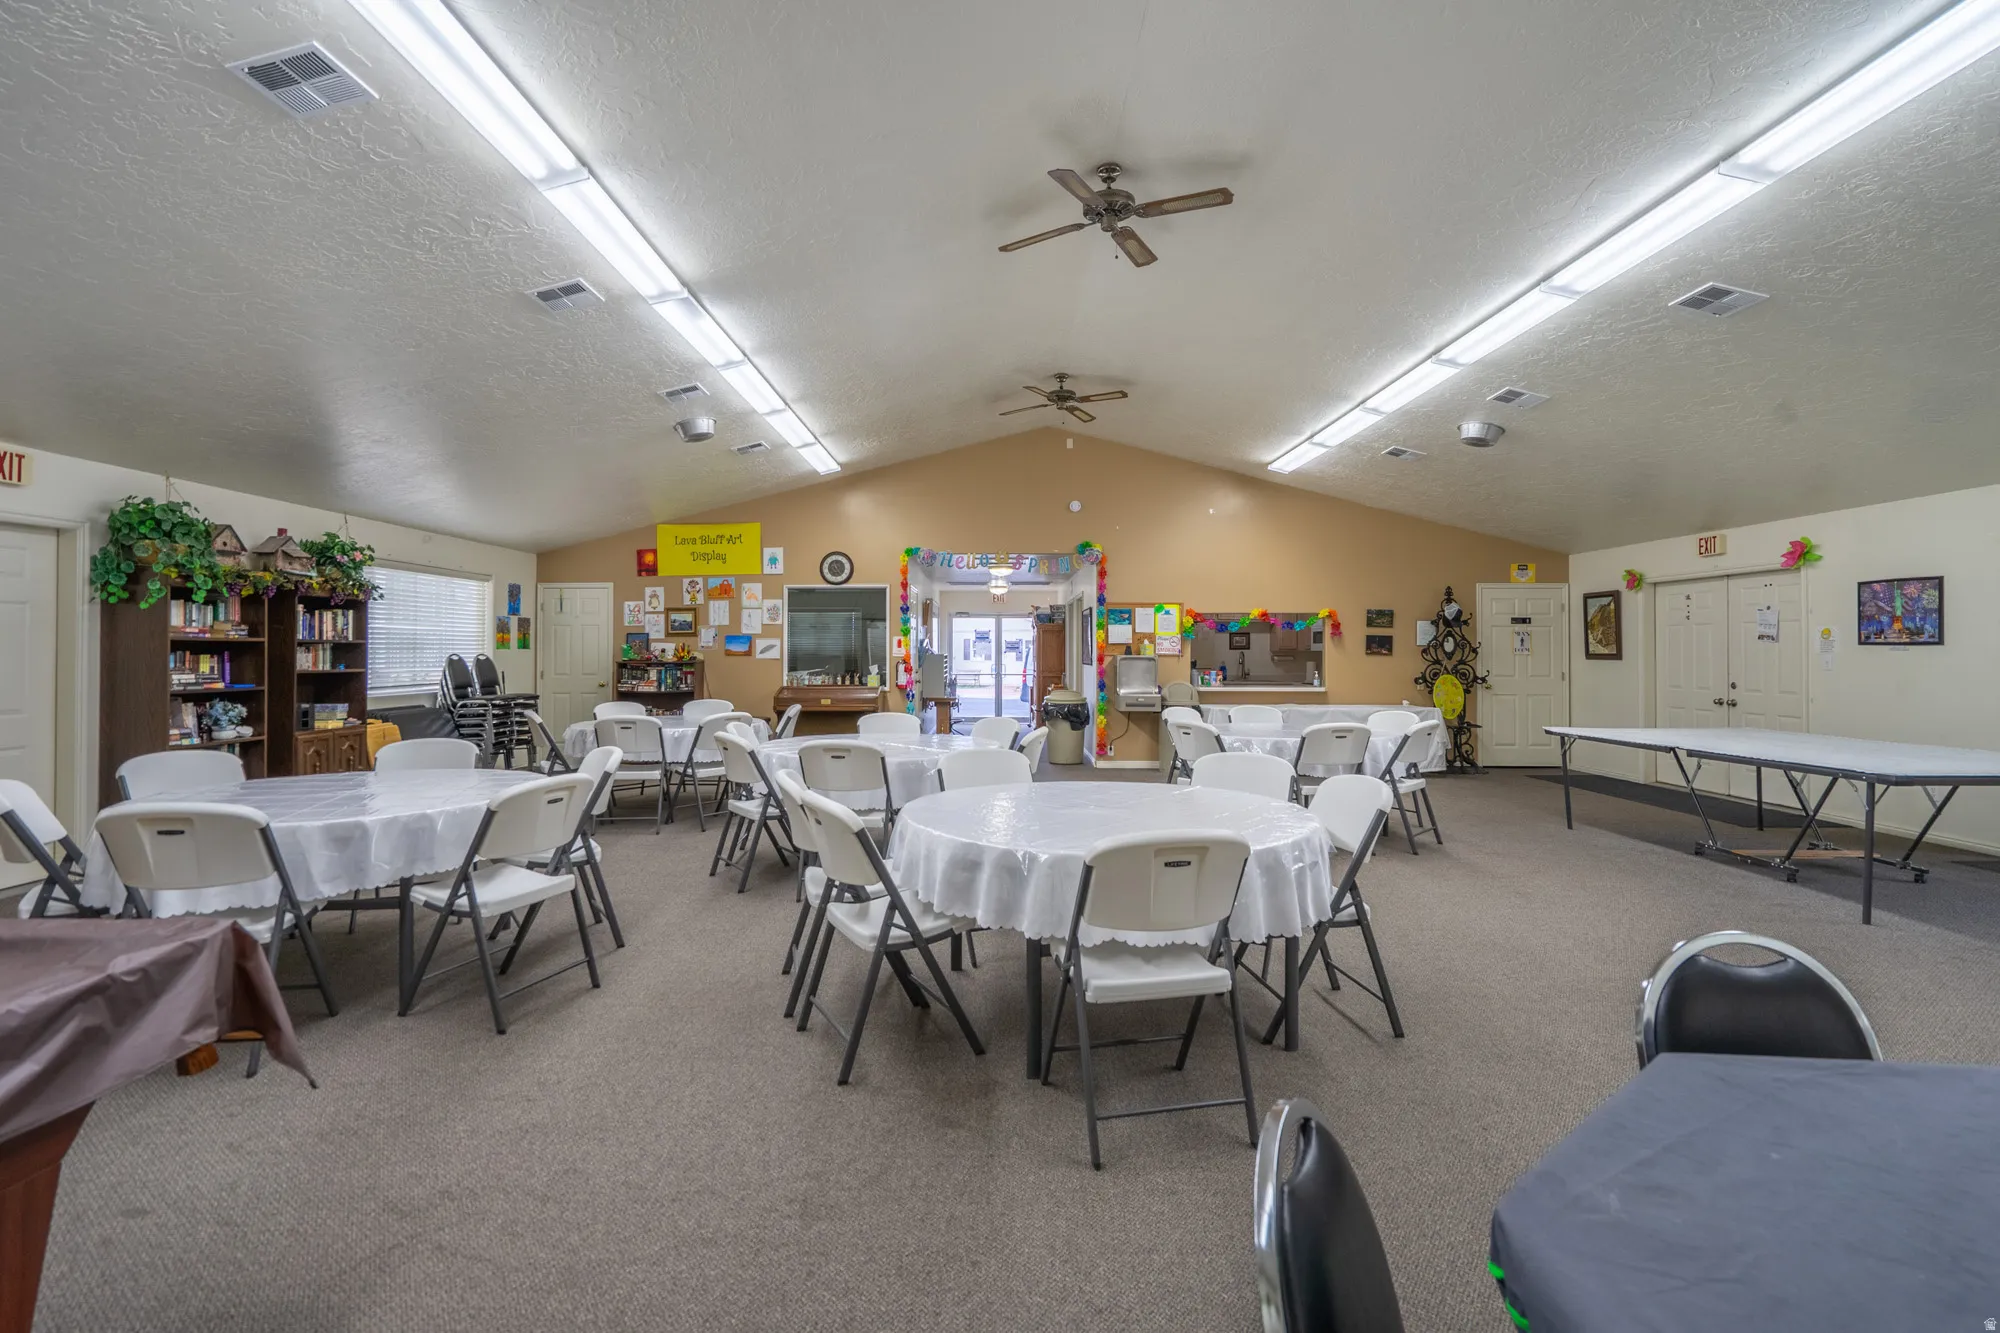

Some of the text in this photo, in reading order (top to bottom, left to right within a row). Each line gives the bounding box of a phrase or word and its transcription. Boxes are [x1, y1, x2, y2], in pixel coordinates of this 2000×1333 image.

[674, 533, 743, 546] Lava Bluff Art
[1699, 535, 1717, 555] EXIT
[690, 549, 727, 564] Display
[938, 551, 989, 570] Hello
